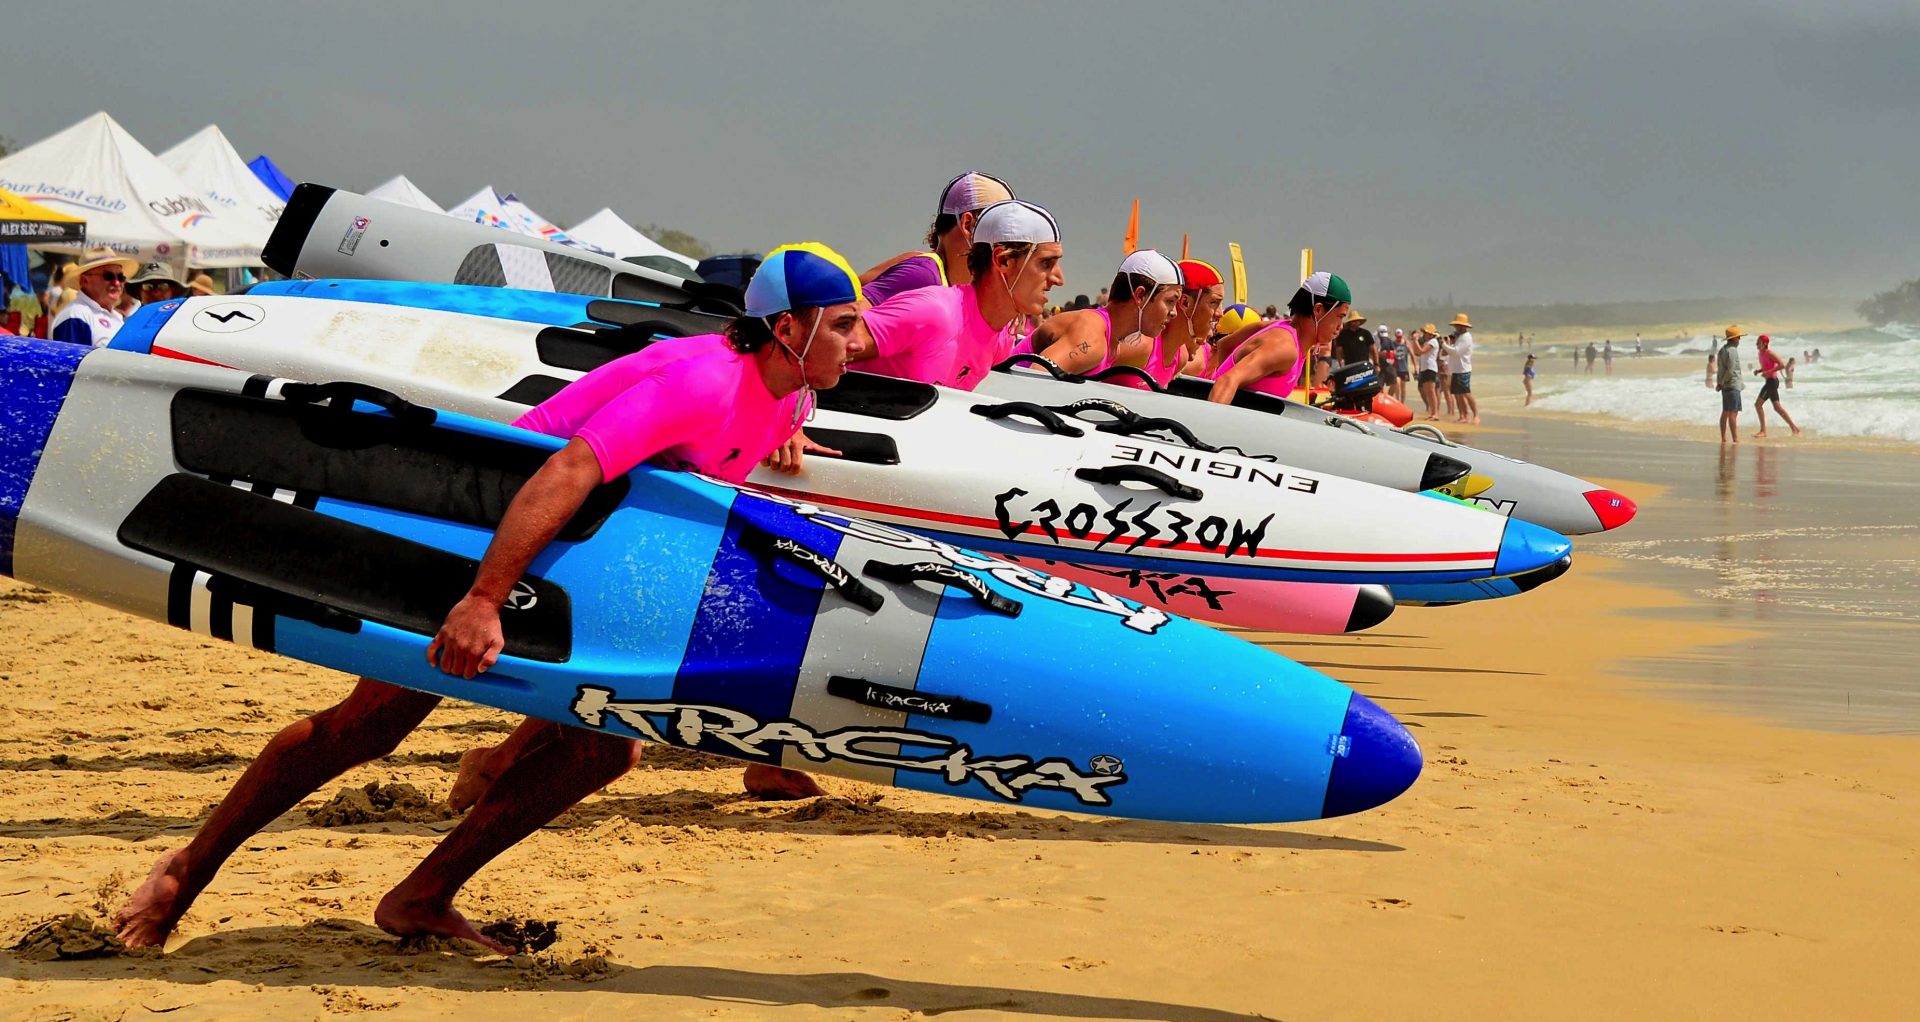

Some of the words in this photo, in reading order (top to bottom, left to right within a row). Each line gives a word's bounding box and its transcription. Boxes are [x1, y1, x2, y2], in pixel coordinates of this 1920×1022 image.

[36, 182, 84, 199] local
[86, 194, 127, 211] club
[1, 222, 20, 236] ALEX
[1111, 444, 1320, 495] ENGINE
[995, 487, 1275, 559] CROSSBOW
[773, 539, 848, 587] KRACKA
[911, 562, 990, 600] KRACKA
[866, 686, 951, 714] KRACKA
[570, 684, 1127, 806] KRACKA
